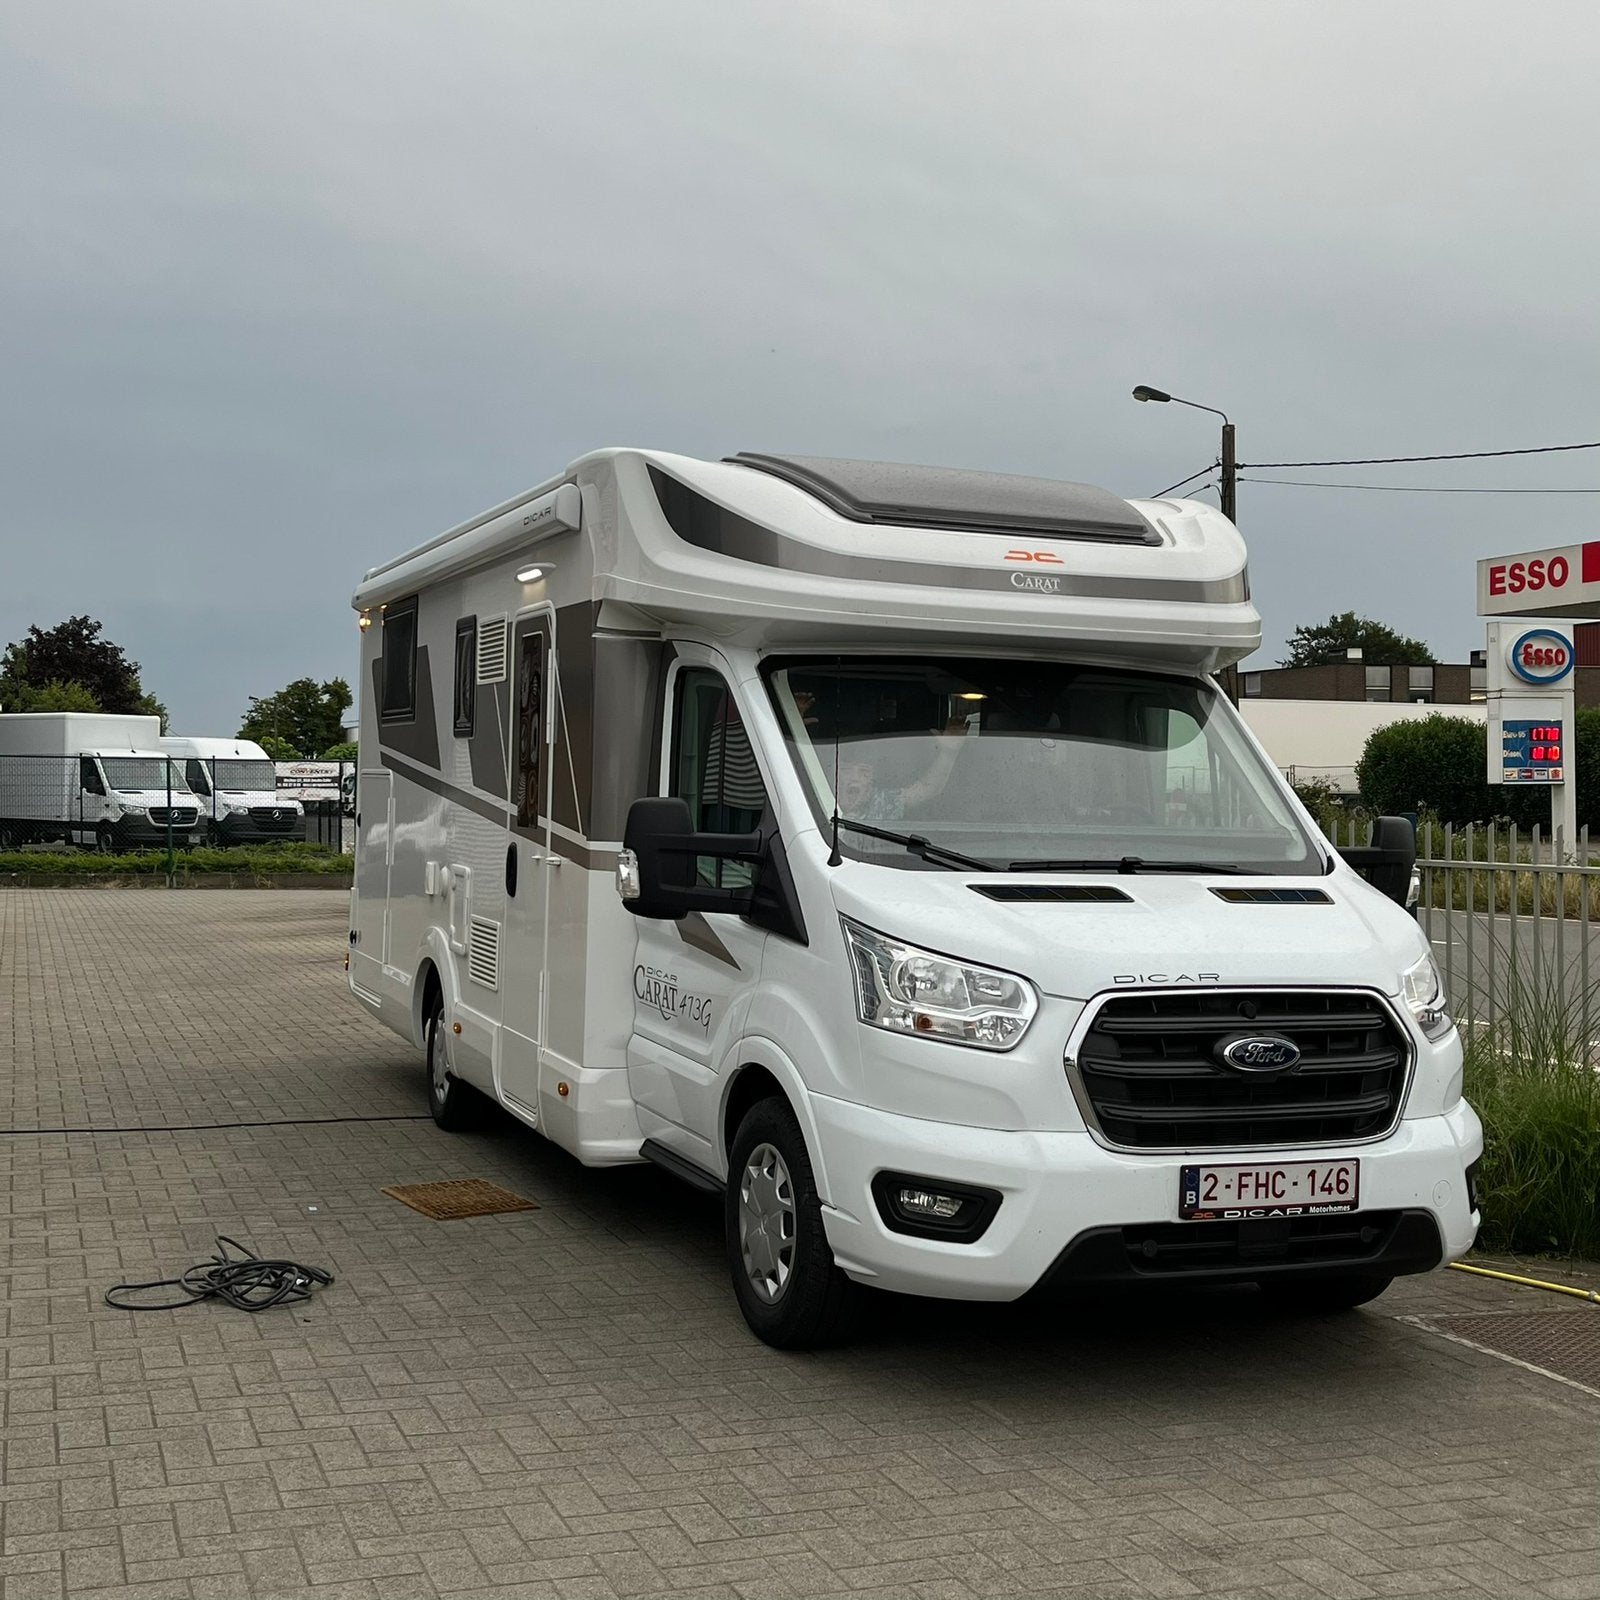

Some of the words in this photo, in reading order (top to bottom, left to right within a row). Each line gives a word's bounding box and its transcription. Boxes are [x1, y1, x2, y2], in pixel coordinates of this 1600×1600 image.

[523, 506, 552, 526] DICAR
[1489, 555, 1569, 596] ESSO
[646, 966, 678, 983] DICAR
[1112, 973, 1221, 985] DICAR
[1244, 1042, 1286, 1063] Ford
[1202, 1166, 1351, 1202] 2-FHC-146
[1185, 1190, 1197, 1205] B
[1223, 1207, 1303, 1219] DICAR
[1308, 1204, 1351, 1214] Motorhomes
